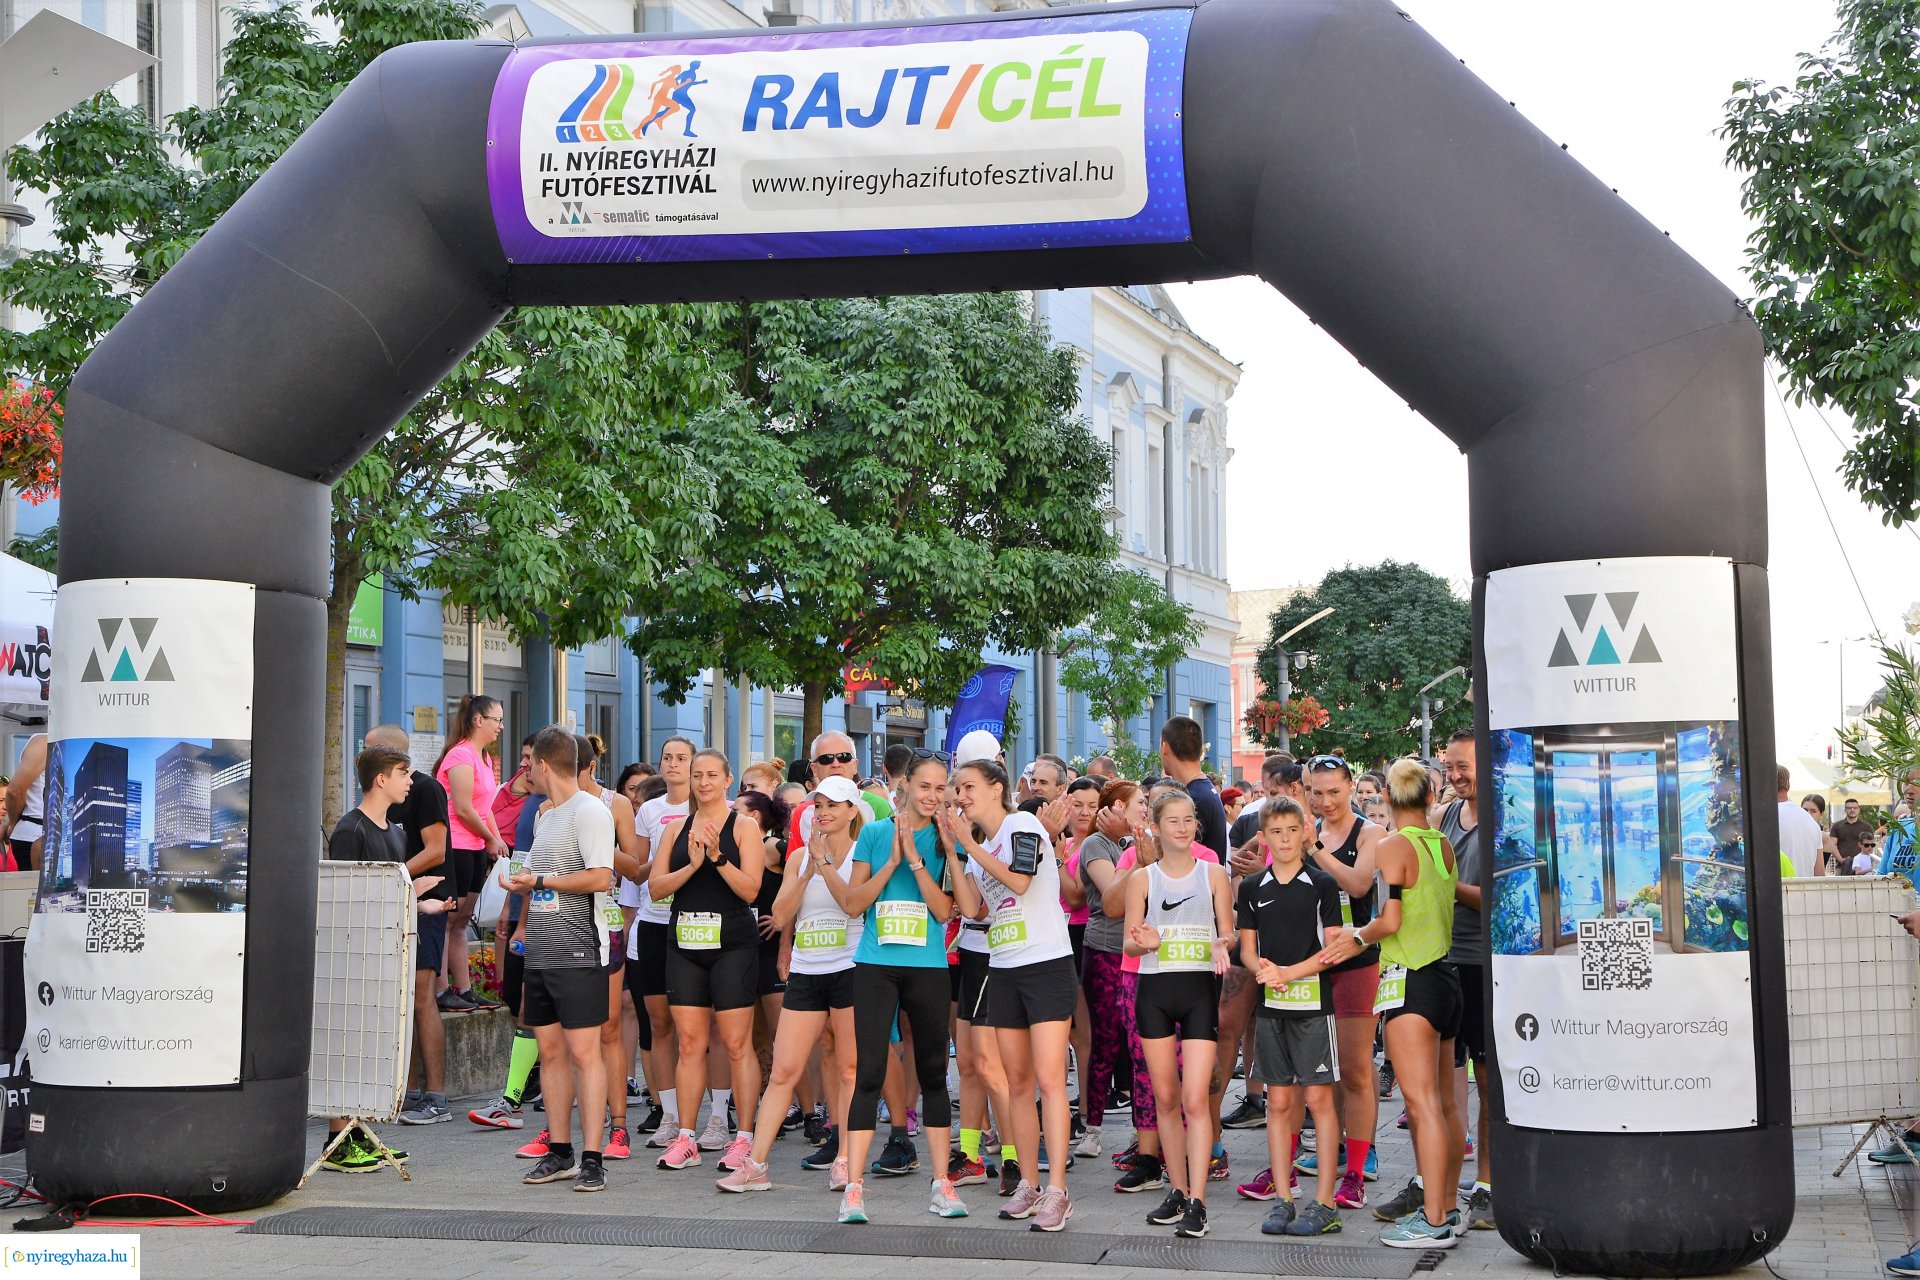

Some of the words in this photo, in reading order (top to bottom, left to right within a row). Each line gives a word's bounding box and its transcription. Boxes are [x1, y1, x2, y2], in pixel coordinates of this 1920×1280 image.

[742, 44, 1122, 132] RAJT/CÉL
[539, 152, 559, 173] II.
[566, 143, 717, 171] NYÍREGYHÁZI
[540, 169, 717, 198] FUTÓFESZTIVÁL
[752, 159, 1114, 197] www.nyiregyhazifutofesztival.hu
[548, 217, 554, 225] a
[602, 209, 650, 224] sematic
[655, 211, 719, 224] támogatásával
[1573, 676, 1637, 694] WITTUR
[98, 692, 150, 707] WITTUR
[681, 928, 714, 942] 5064
[883, 919, 918, 935] 5117
[991, 925, 1019, 945] 5049
[803, 931, 838, 947] 5100
[1167, 943, 1205, 959] 5143
[61, 985, 97, 1001] Wittur
[102, 985, 214, 1004] Magyarország
[1550, 1018, 1601, 1035] Wittur
[1606, 1016, 1729, 1039] Magyarország
[59, 1034, 193, 1051] karrier@wittur.com
[1552, 1073, 1712, 1092] karrier@wittur.com
